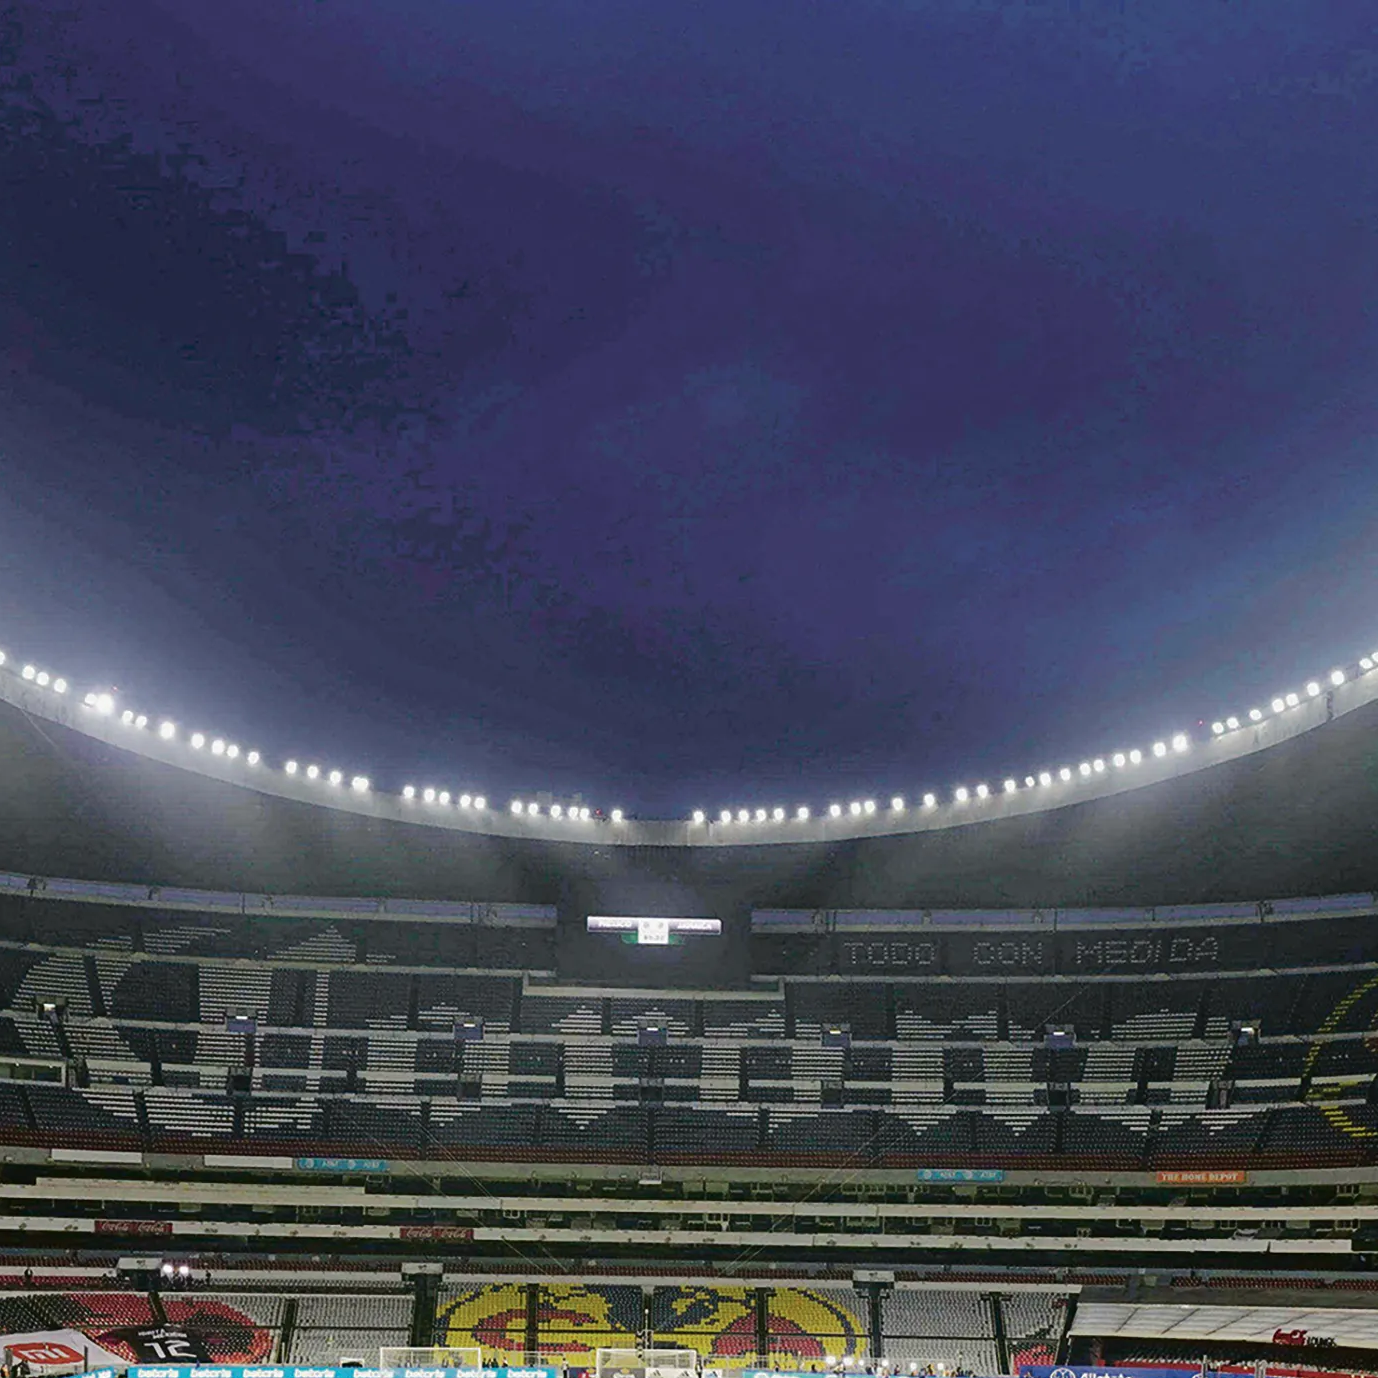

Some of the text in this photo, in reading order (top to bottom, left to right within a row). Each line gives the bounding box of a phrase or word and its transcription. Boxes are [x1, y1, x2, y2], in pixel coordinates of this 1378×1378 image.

[844, 937, 1219, 965] TODO CON MEDIDA
